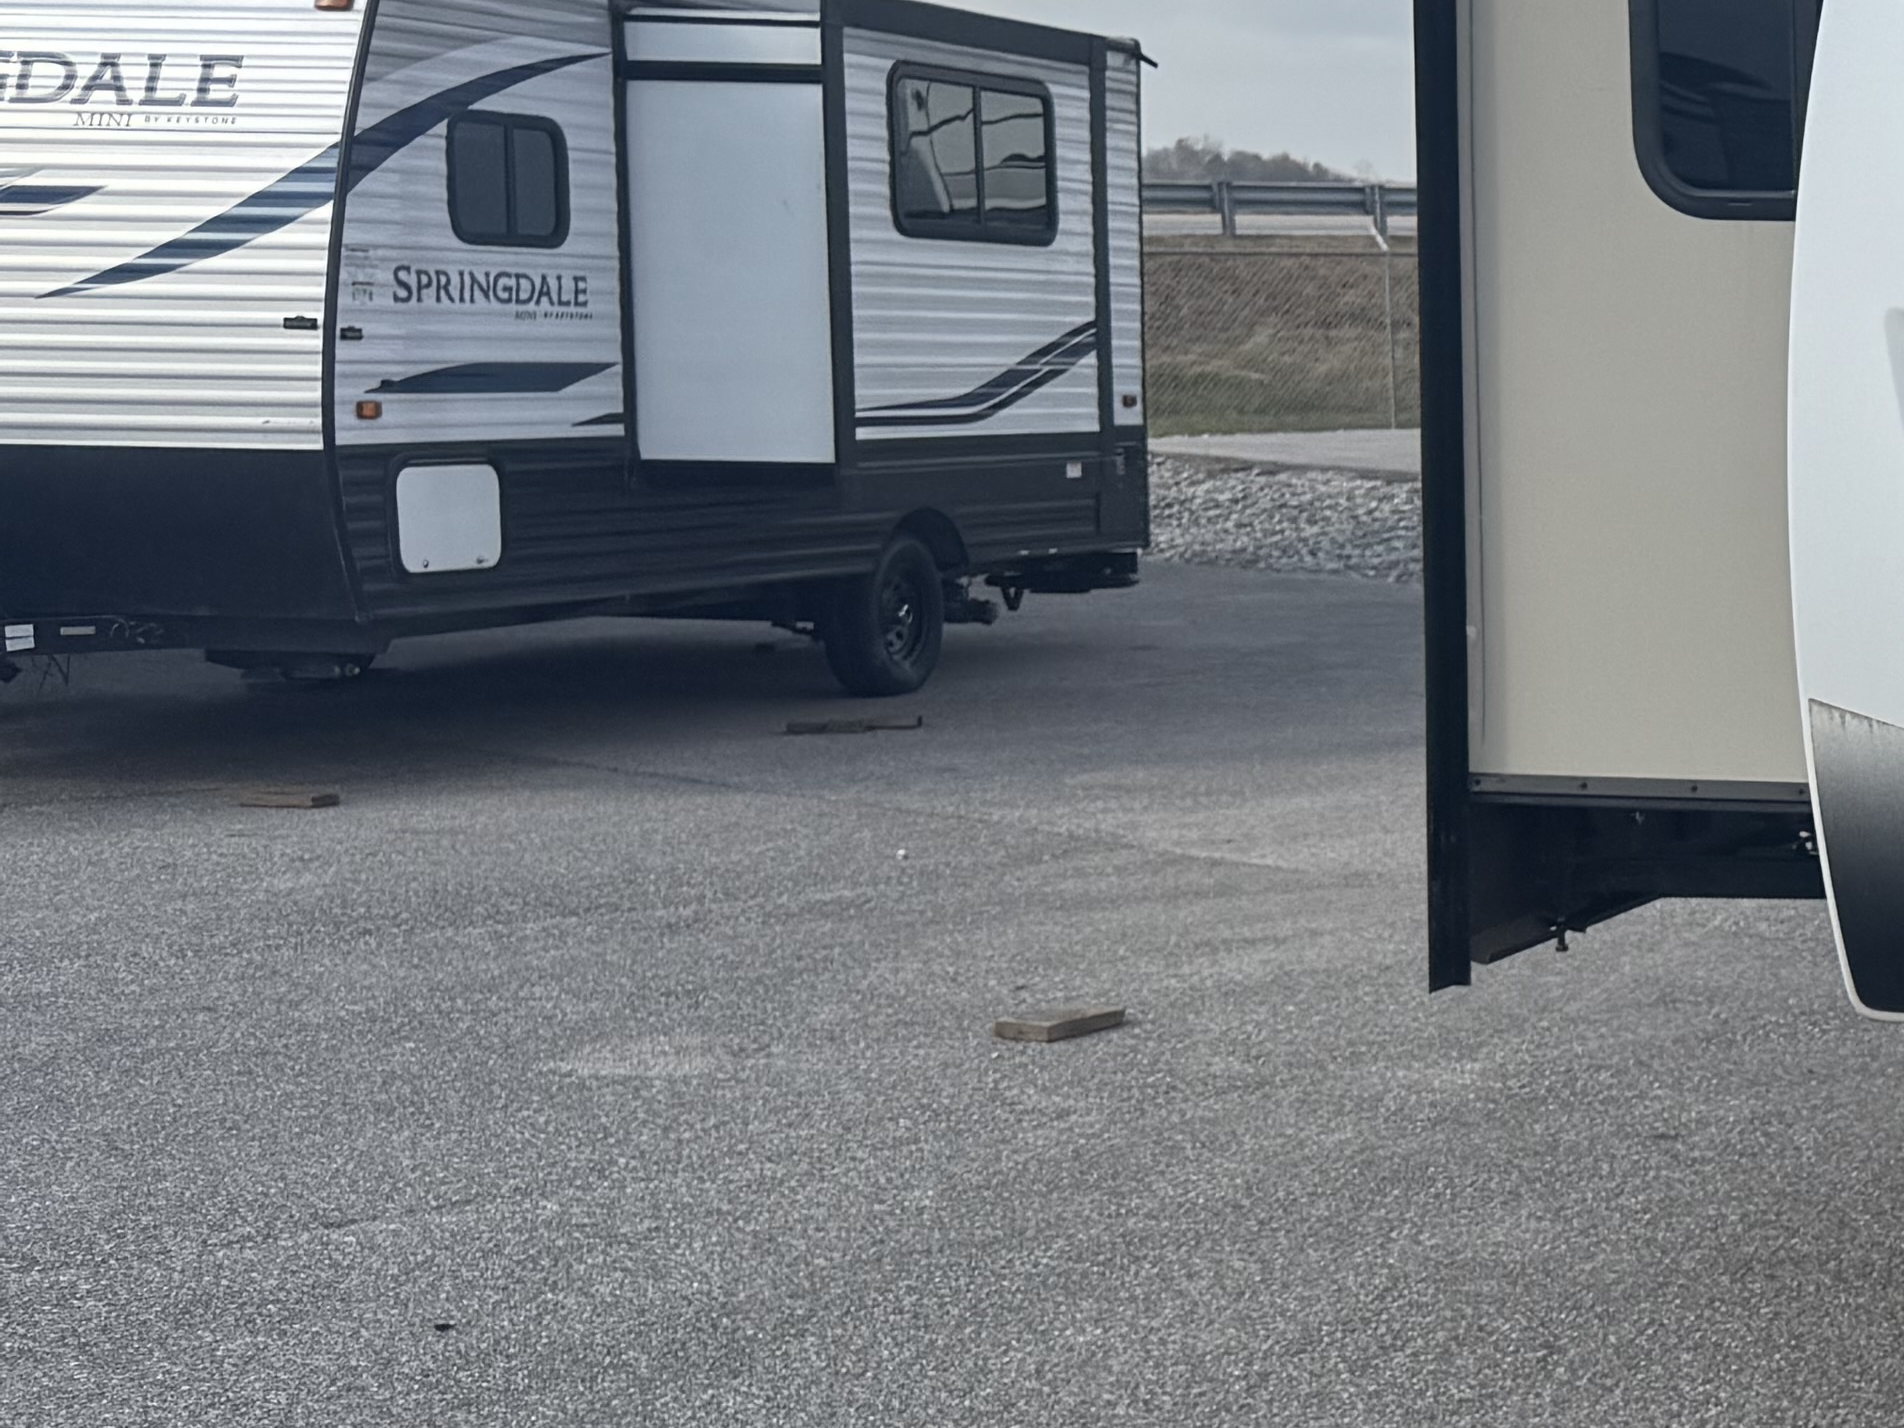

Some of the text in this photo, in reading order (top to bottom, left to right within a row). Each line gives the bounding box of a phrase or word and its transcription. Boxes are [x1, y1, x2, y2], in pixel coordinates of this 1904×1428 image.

[0, 50, 245, 108] DALE
[73, 111, 133, 127] MINI
[393, 264, 589, 308] SPRINGDALE
